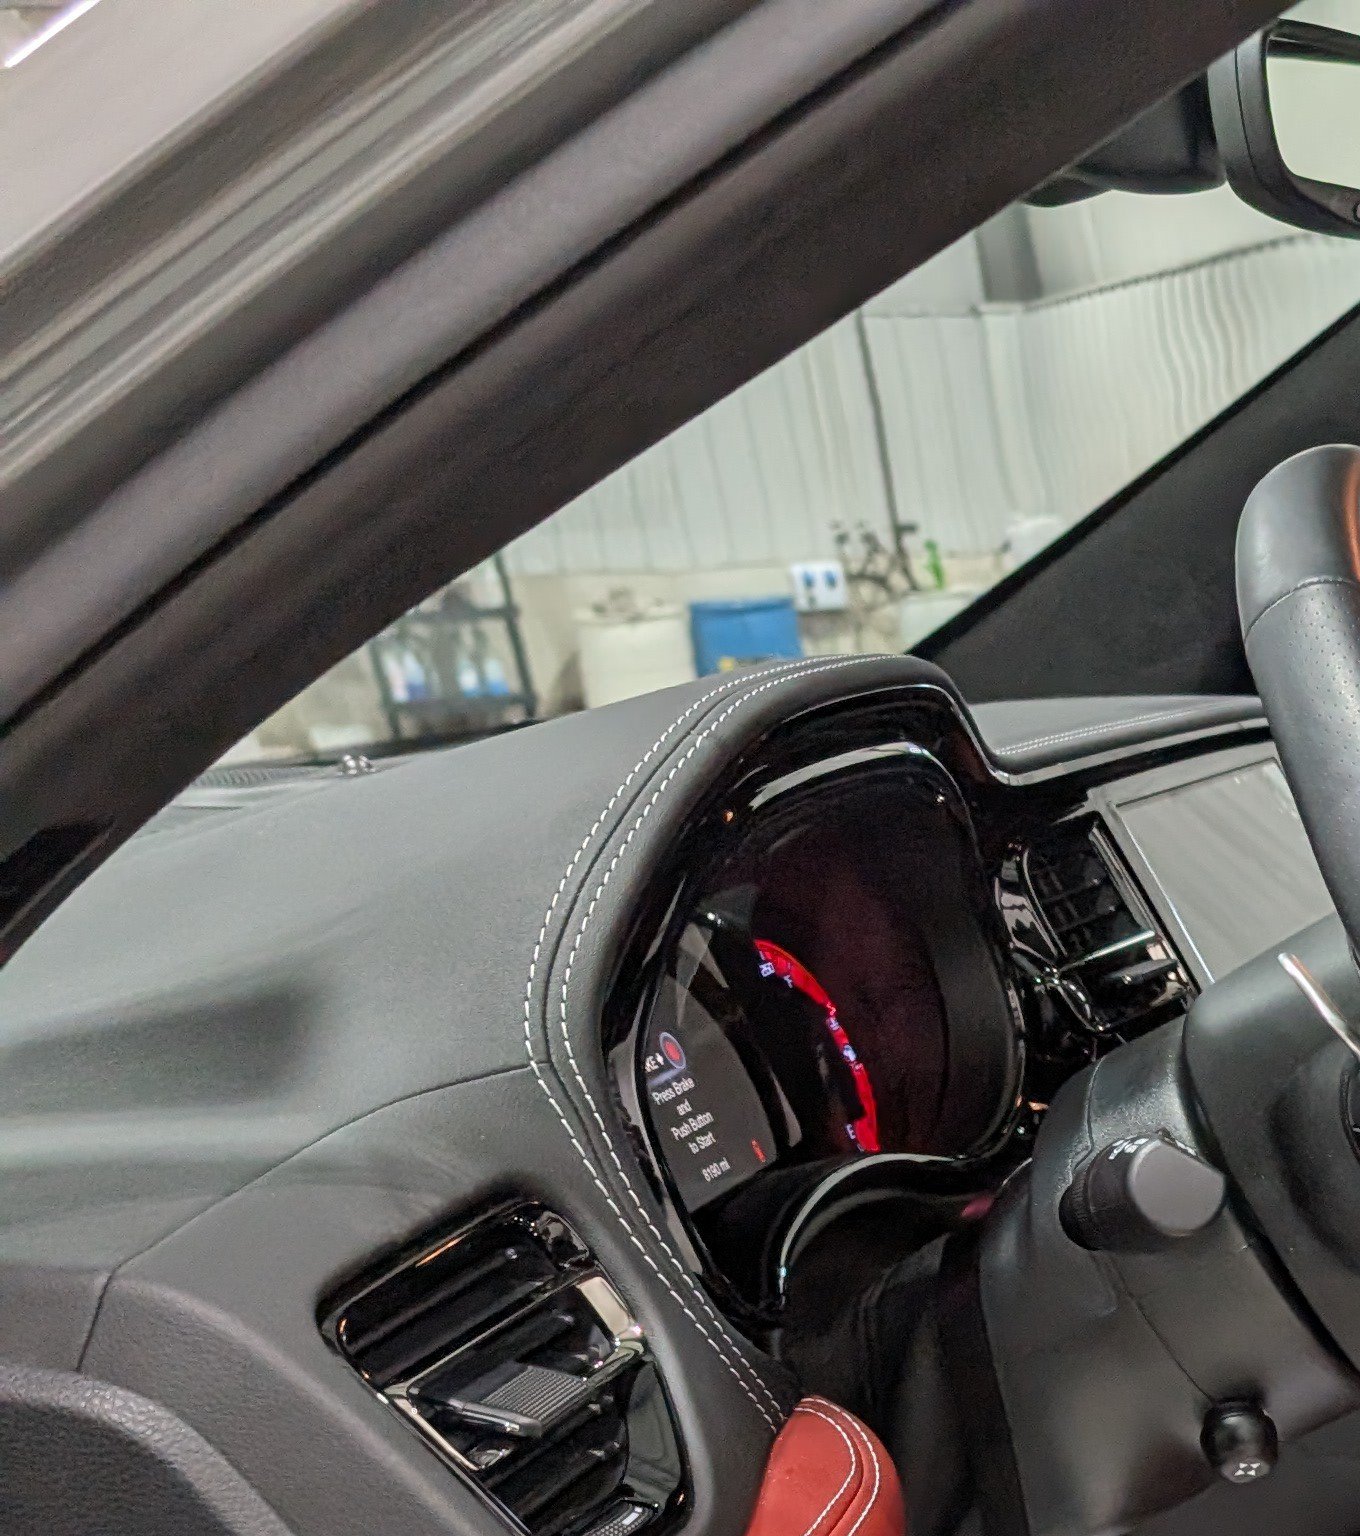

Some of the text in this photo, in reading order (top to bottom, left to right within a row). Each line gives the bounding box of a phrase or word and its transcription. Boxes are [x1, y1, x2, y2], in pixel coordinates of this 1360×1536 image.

[652, 1077, 695, 1105] Press Brake
[676, 1099, 692, 1116] and
[671, 1112, 714, 1141] Push Button
[688, 1131, 716, 1154] to Start
